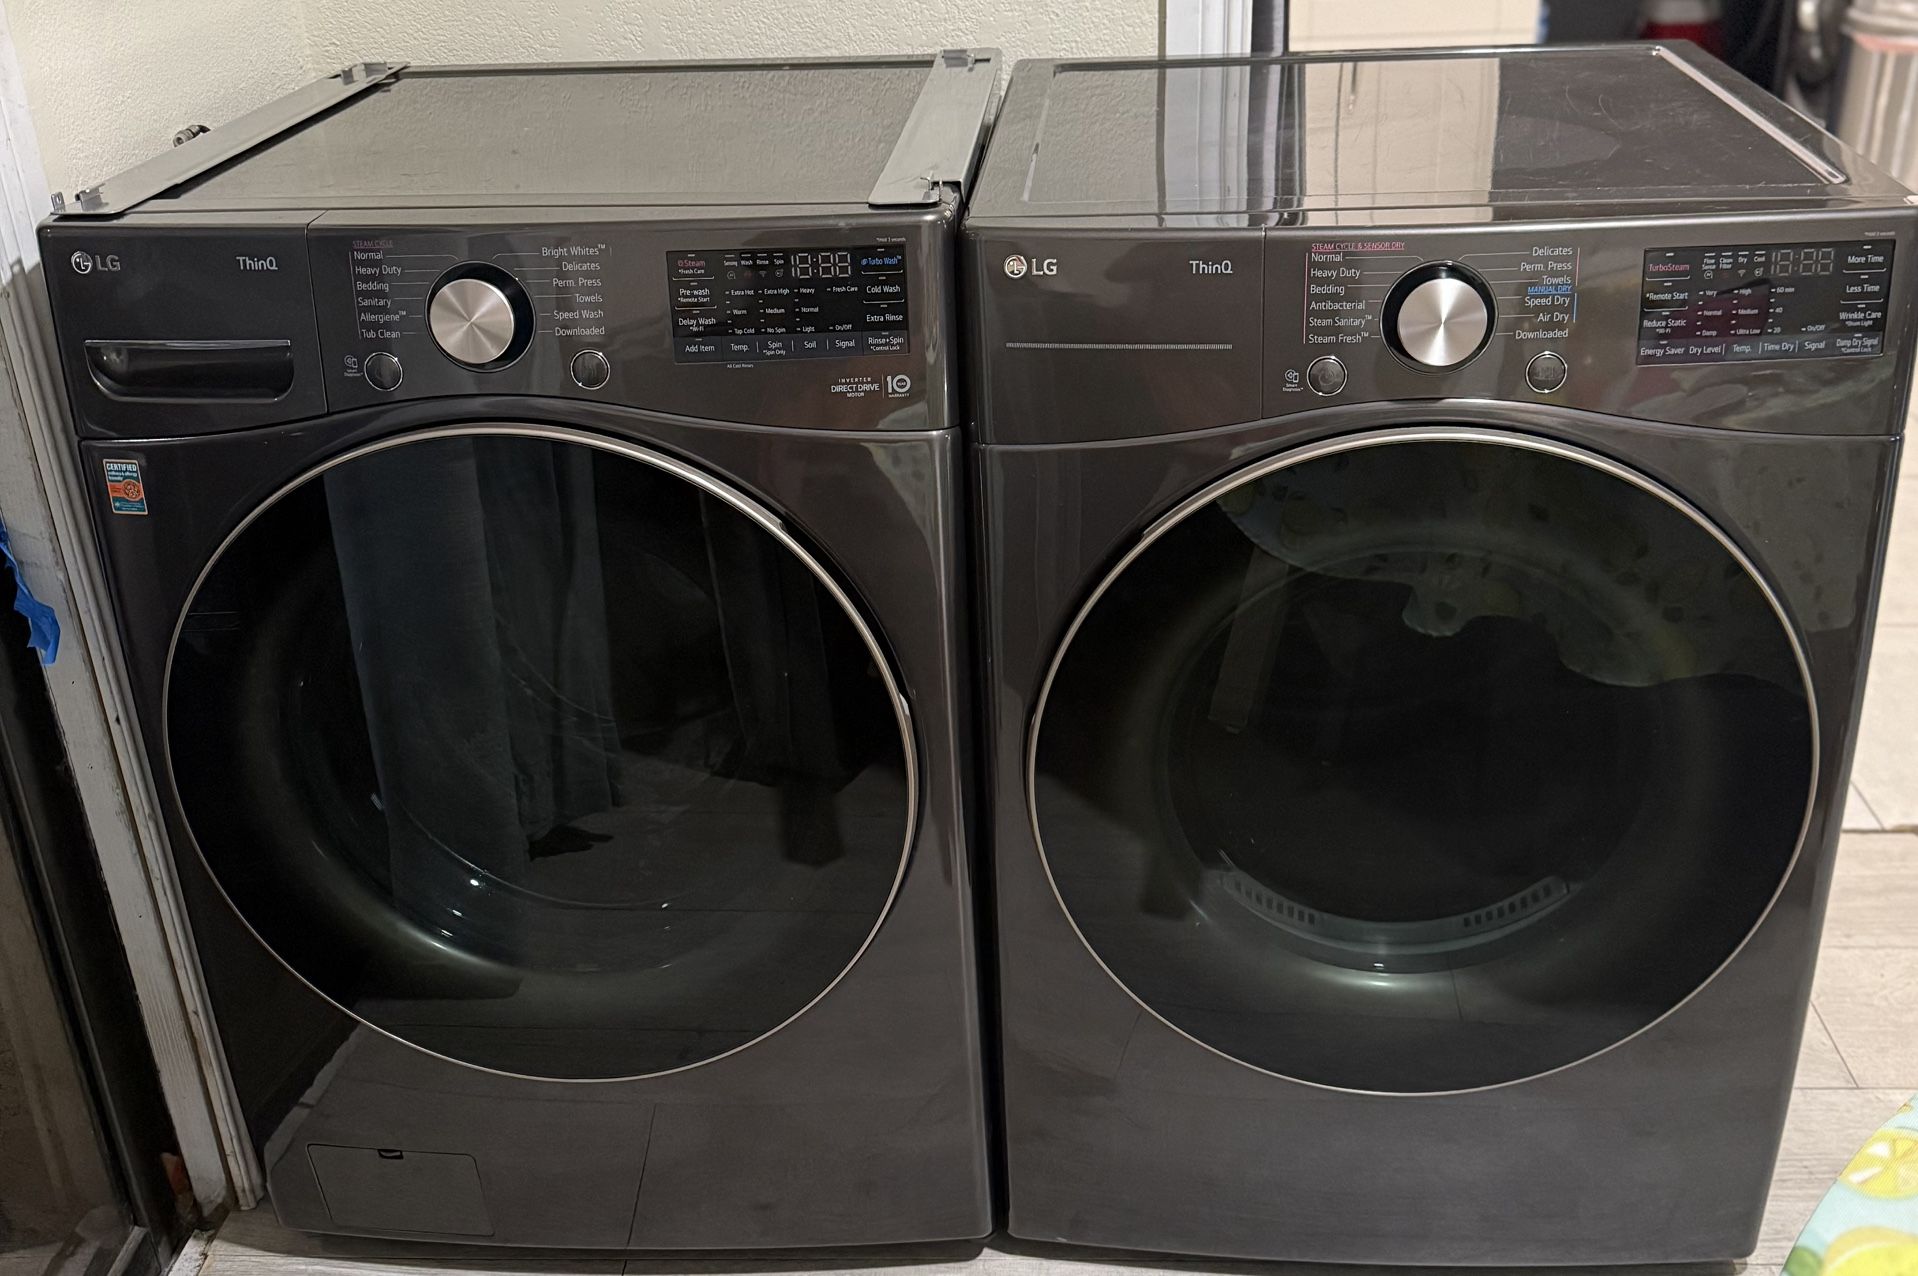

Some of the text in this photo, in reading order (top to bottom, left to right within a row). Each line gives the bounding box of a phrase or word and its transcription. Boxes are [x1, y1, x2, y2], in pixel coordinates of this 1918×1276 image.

[1364, 242, 1390, 250] SENSOR
[354, 251, 383, 259] Normal
[542, 247, 567, 258] Bright
[1533, 247, 1572, 256] Delicates
[1312, 252, 1342, 261] Normal
[95, 255, 120, 271] LG
[236, 257, 278, 270] ThinQ
[562, 262, 600, 270] Delicates
[1032, 259, 1057, 275] LG
[1189, 260, 1233, 274] ThinQ
[1521, 261, 1572, 271] Perm. Press
[355, 265, 401, 276] Heavy Duty
[1311, 267, 1360, 279] Heavy Duty
[553, 277, 601, 287] Perm. Press
[1542, 275, 1571, 284] Towels
[357, 282, 389, 292] Bedding
[1311, 285, 1344, 295] Bedding
[1846, 284, 1879, 293] Less Time
[680, 288, 710, 296] Pre-wash
[1673, 292, 1688, 300] Start
[574, 293, 602, 302] Towels
[1525, 295, 1570, 308] Speed Dry
[358, 297, 391, 308] Sanitary
[1310, 301, 1365, 310] Antibacterial
[554, 309, 603, 320] Speed Wash
[1538, 312, 1569, 323] Air Dry
[1840, 311, 1881, 320] Wrinkle Care
[679, 317, 715, 326] Delay Wash
[1309, 317, 1332, 326] Steam
[362, 330, 400, 338] Tub Clean
[555, 326, 604, 336] Downloaded
[1516, 328, 1568, 339] Downloaded
[1308, 334, 1335, 343] Steam
[730, 344, 749, 352] Temp.
[768, 341, 782, 349] Spin
[836, 340, 855, 348] Signal
[1782, 343, 1794, 351] Dry
[1804, 341, 1825, 351] Signal
[1641, 348, 1664, 356] Energy
[1689, 346, 1702, 355] Dry
[107, 463, 136, 471] CERTIFIED
